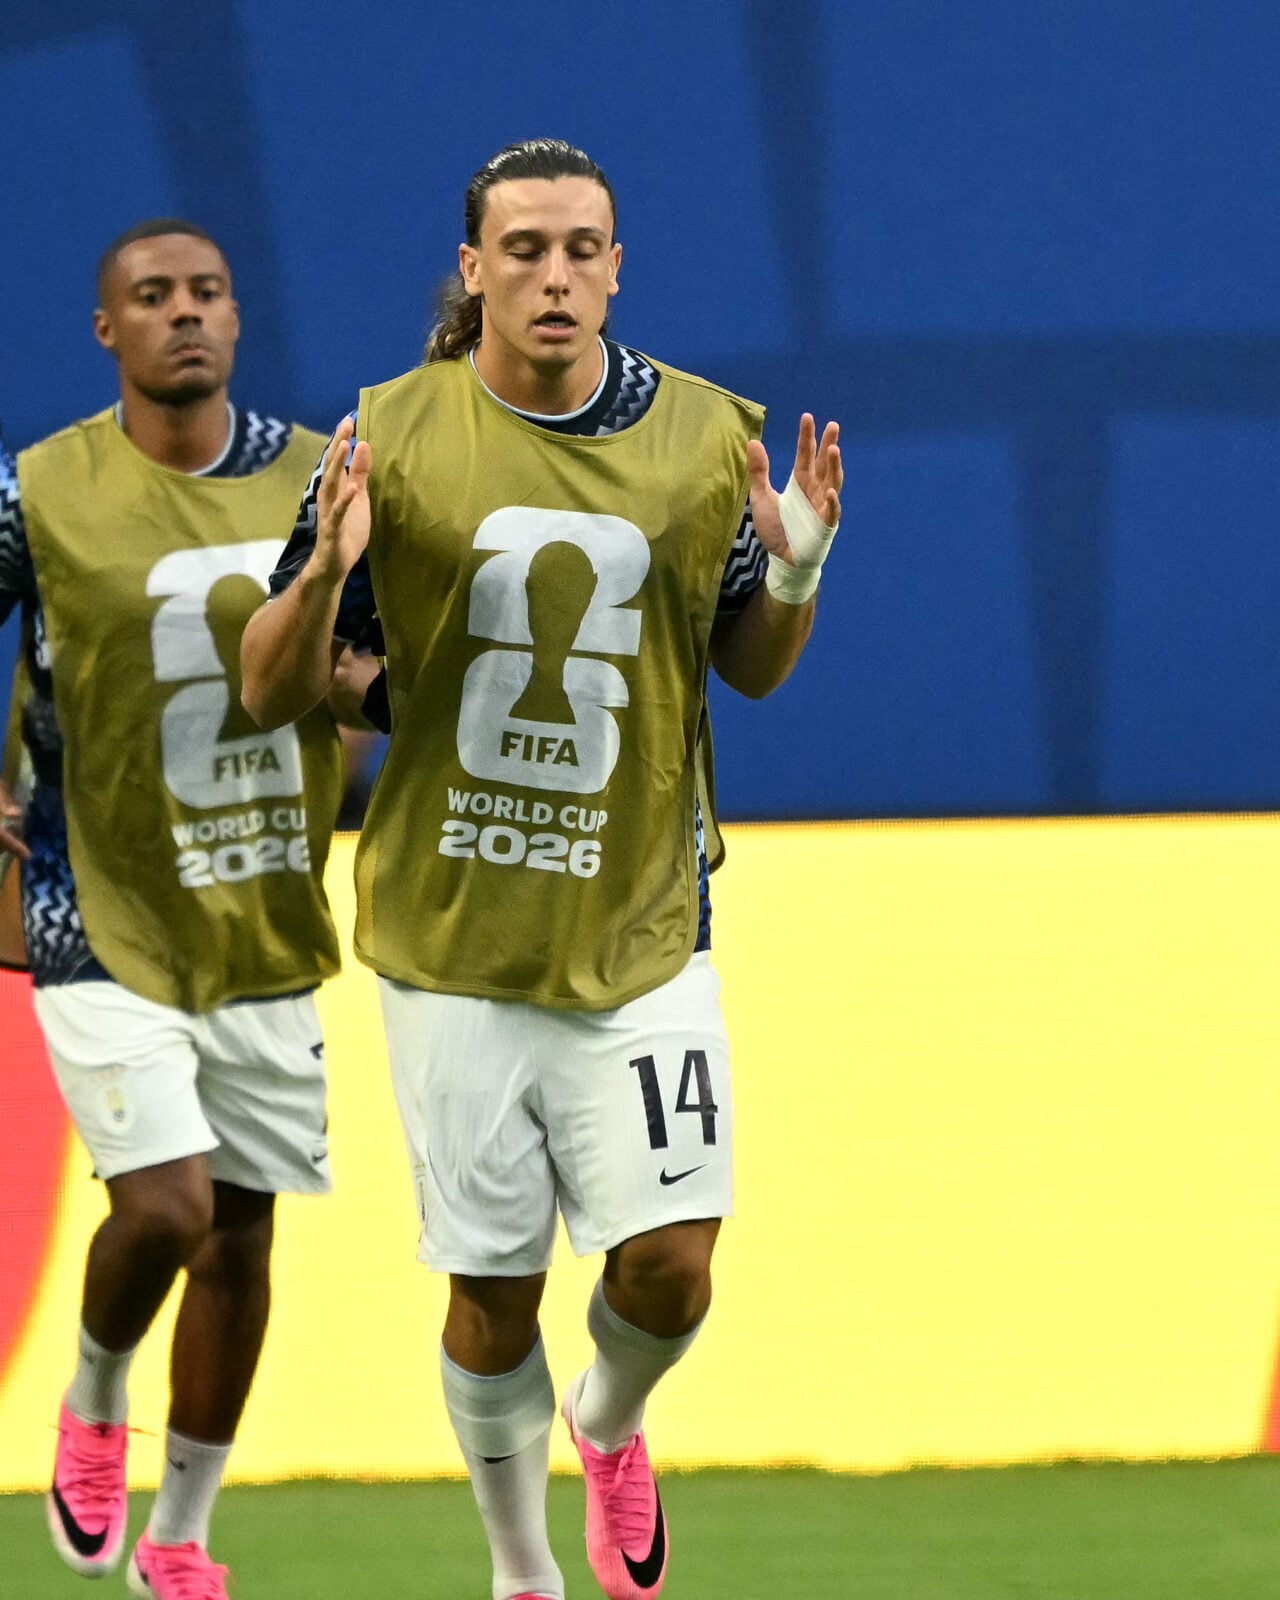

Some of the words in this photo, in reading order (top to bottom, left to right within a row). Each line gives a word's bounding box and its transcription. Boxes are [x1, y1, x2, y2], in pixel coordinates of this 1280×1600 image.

[212, 747, 282, 783] FIFA
[499, 731, 579, 767] FIFA
[171, 809, 266, 848] WORLD
[271, 807, 307, 831] CU
[447, 787, 553, 825] WORLD
[559, 805, 608, 832] CUP
[175, 835, 311, 888] 2026
[438, 820, 603, 879] 2026
[628, 1049, 719, 1151] 14
